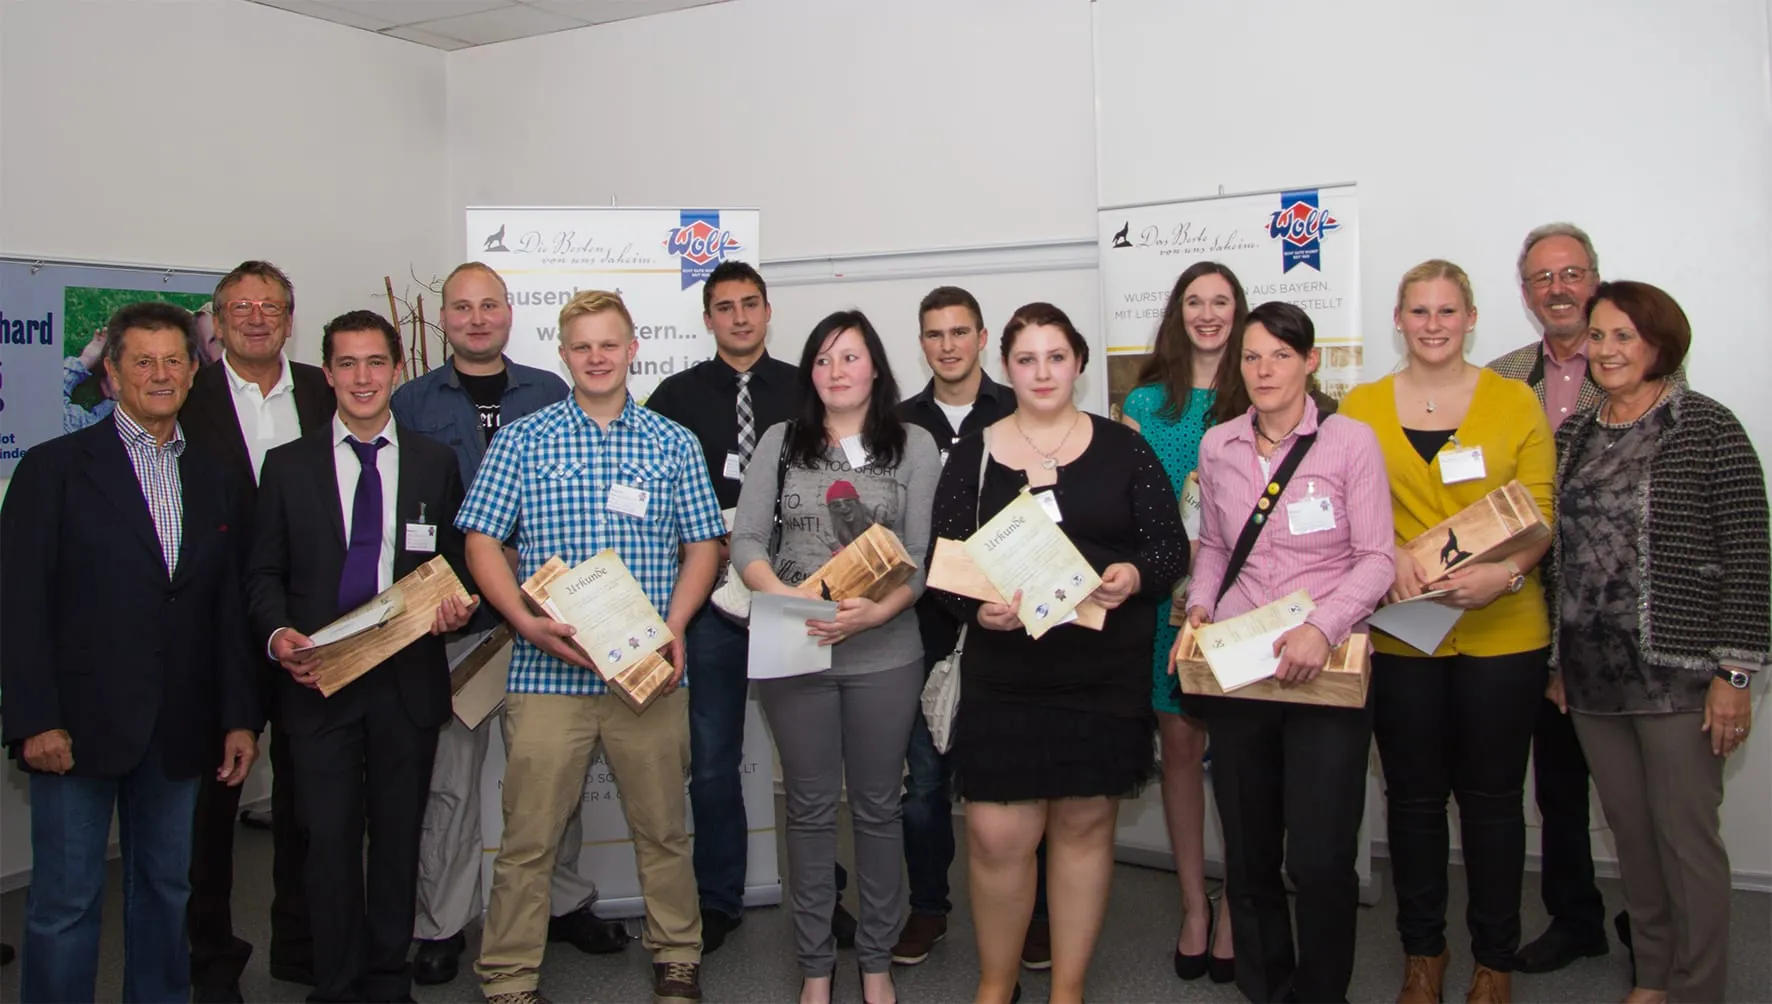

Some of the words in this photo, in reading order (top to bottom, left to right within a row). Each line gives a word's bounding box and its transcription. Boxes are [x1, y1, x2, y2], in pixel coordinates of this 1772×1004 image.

[1136, 225, 1169, 247] Das
[1172, 222, 1208, 246] Beste
[1270, 209, 1339, 239] Wolf
[667, 228, 740, 259] Wolf
[1253, 285, 1277, 295] AUS
[1279, 281, 1331, 294] BAYERN,
[1114, 311, 1132, 320] MIT
[629, 355, 674, 375] und
[823, 460, 851, 472] TOO
[983, 514, 1026, 552] Urkunde
[565, 565, 608, 596] Urkunde
